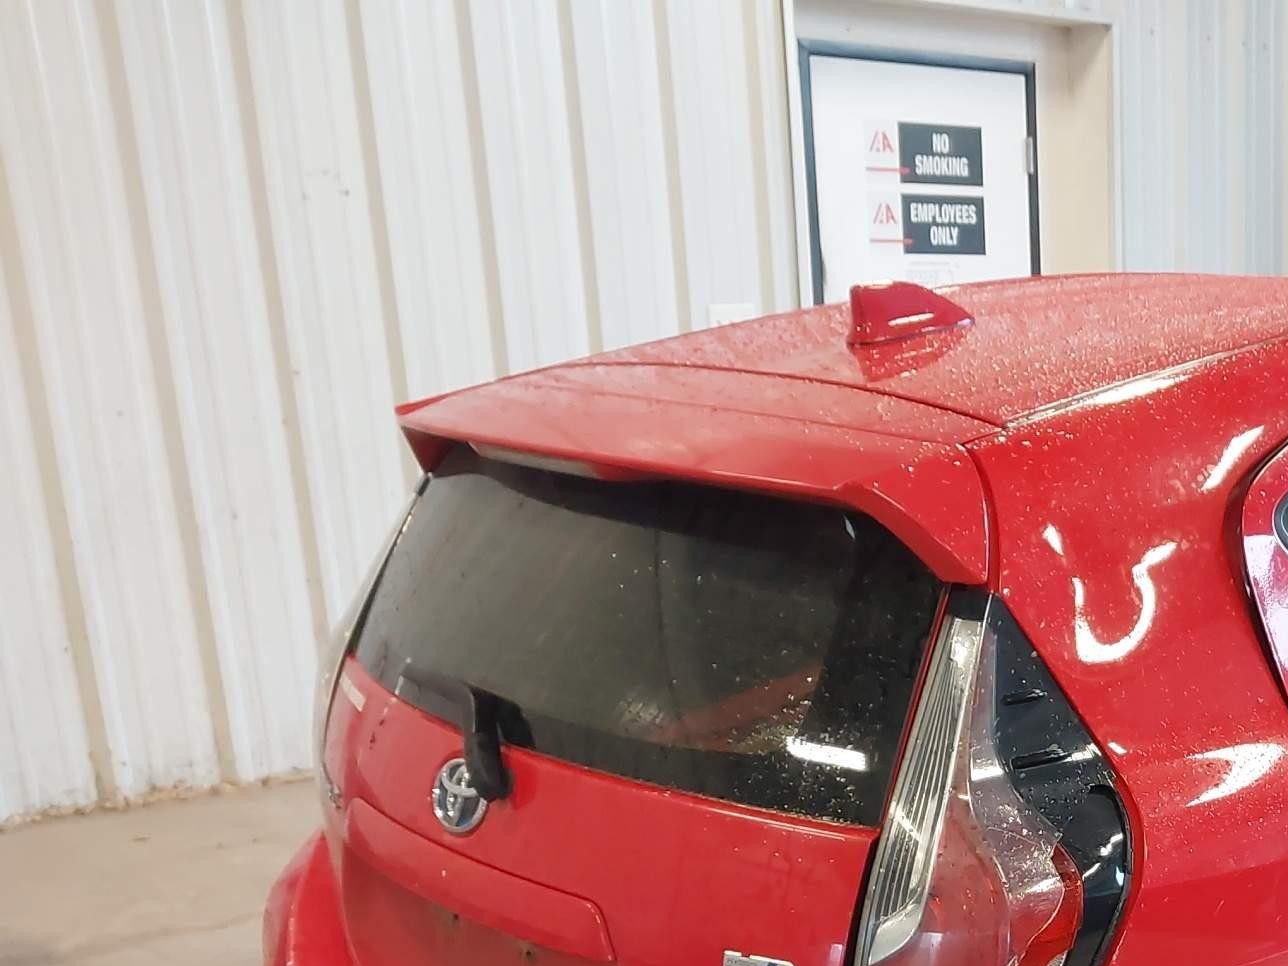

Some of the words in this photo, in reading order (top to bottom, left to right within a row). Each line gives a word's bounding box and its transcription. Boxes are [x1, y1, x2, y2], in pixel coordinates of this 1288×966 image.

[932, 132, 949, 154] NO
[915, 155, 968, 177] SMOKING
[910, 202, 977, 225] EMPLOYEES
[930, 225, 958, 246] ONLY
